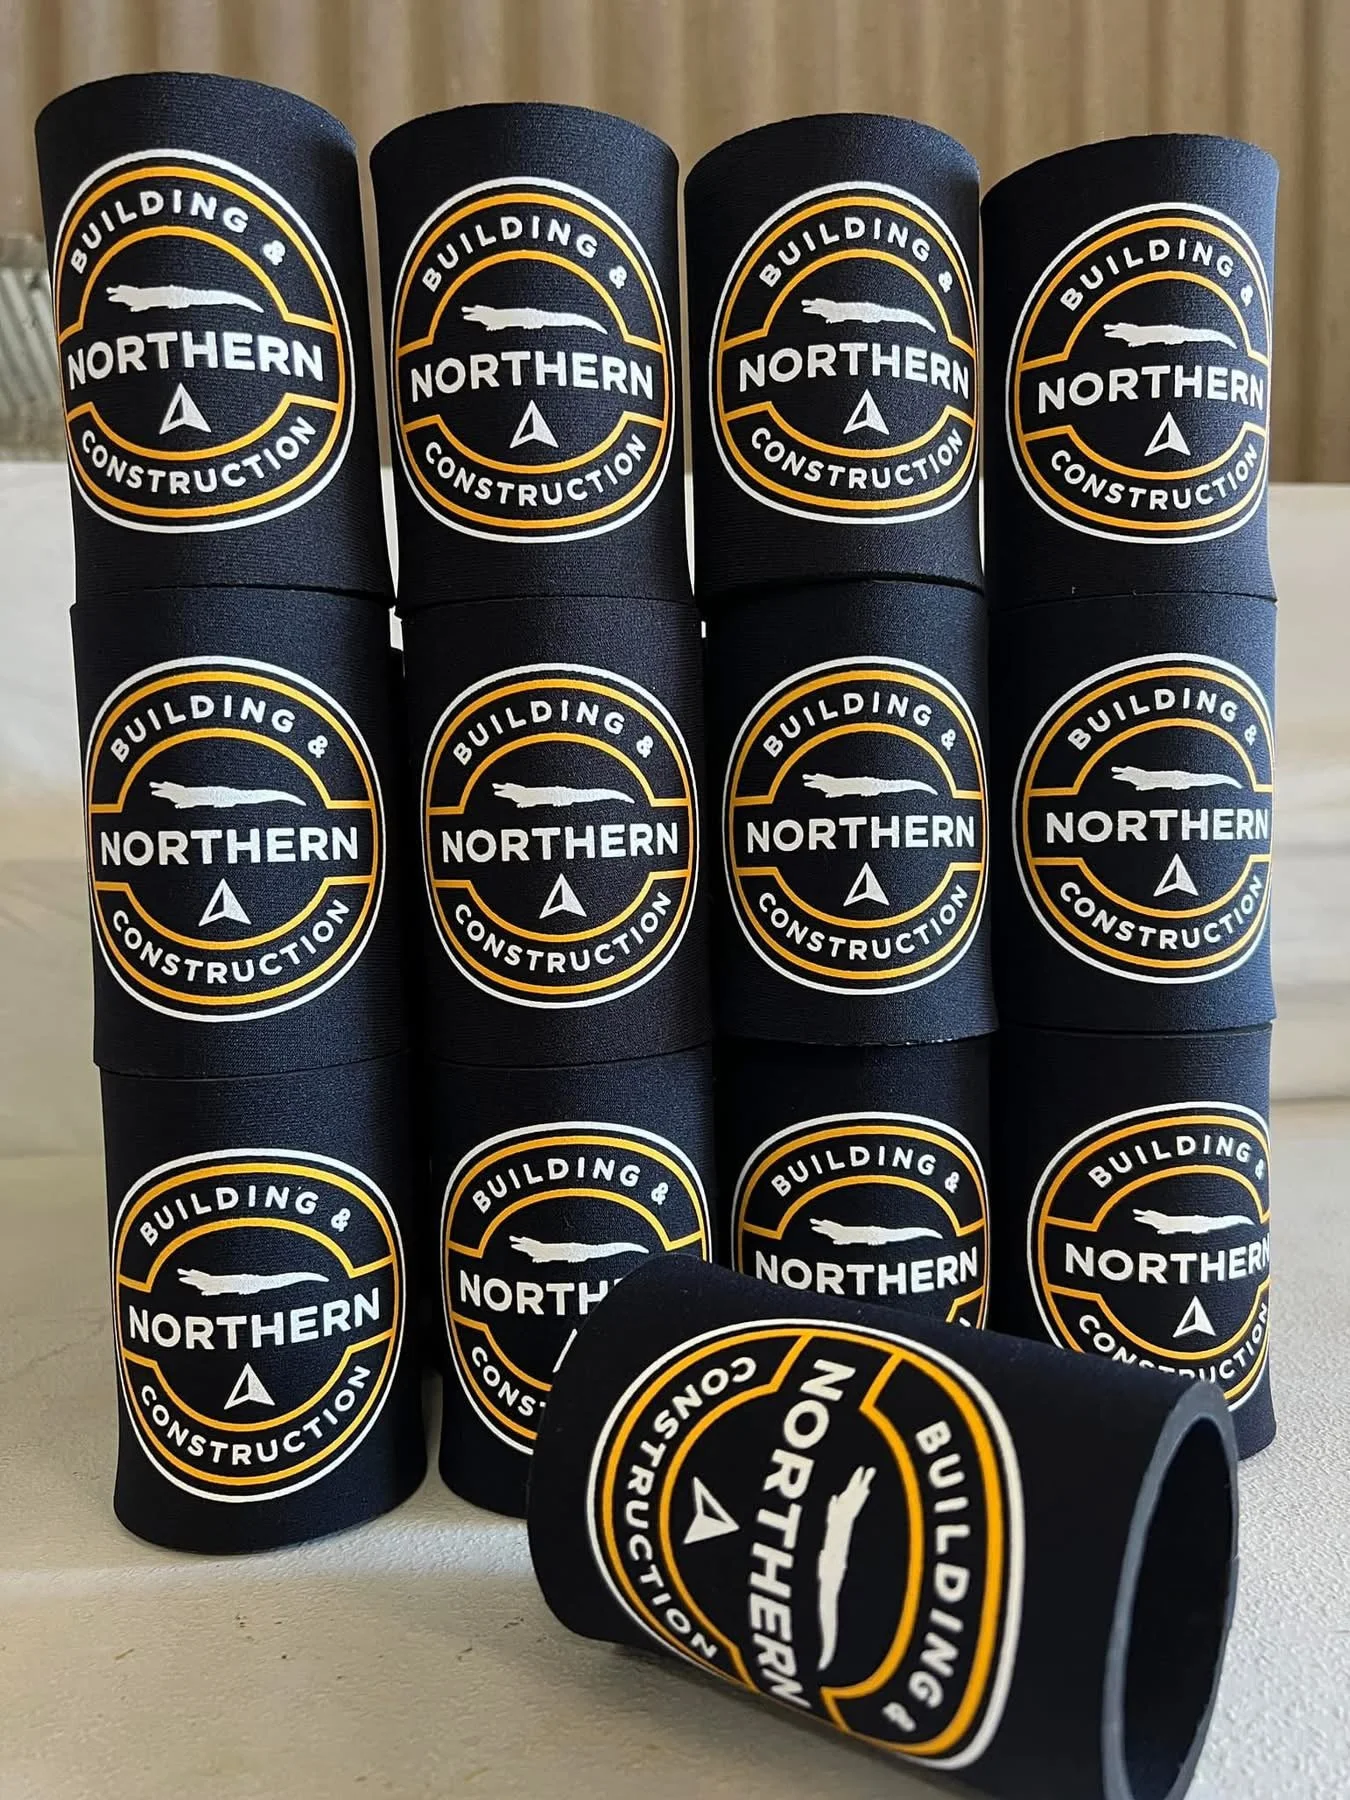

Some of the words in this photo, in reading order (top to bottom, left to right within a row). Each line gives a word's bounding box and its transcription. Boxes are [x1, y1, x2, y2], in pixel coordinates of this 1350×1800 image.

[71, 188, 248, 274] BUILDING
[260, 240, 286, 265] &
[422, 215, 597, 292] BUILDING
[608, 265, 627, 289] &
[759, 216, 930, 287] BUILDING
[938, 271, 953, 294] &
[1060, 238, 1232, 311] BUILDING
[68, 331, 323, 390] NORTHERN
[411, 351, 654, 402] NORTHERN
[739, 342, 968, 399] NORTHERN
[1038, 365, 1263, 414] NORTHERN
[81, 416, 317, 495] CONSTRUCTION
[424, 434, 646, 506] CONSTRUCTION
[751, 429, 963, 488] CONSTRUCTION
[1051, 443, 1257, 510] CONSTRUCTION
[111, 695, 296, 763] BUILDING
[308, 735, 328, 758] &
[453, 700, 625, 765] BUILDING
[636, 735, 654, 758] &
[763, 692, 932, 758] BUILDING
[941, 729, 956, 751] &
[1068, 688, 1239, 750] BUILDING
[101, 827, 358, 866] NORTHERN
[442, 823, 678, 862] NORTHERN
[747, 815, 974, 853] NORTHERN
[1046, 808, 1268, 843] NORTHERN
[113, 900, 350, 984] CONSTRUCTION
[455, 892, 672, 974] CONSTRUCTION
[759, 885, 967, 960] CONSTRUCTION
[1060, 874, 1262, 949] CONSTRUCTION
[473, 1157, 640, 1213] BUILDING
[651, 1182, 669, 1205] &
[771, 1145, 936, 1197] BUILDING
[944, 1171, 960, 1193] &
[1088, 1134, 1252, 1188] BUILDING
[140, 1185, 319, 1246] BUILDING
[331, 1208, 350, 1232] &
[756, 1246, 977, 1295] NORTHERN
[1065, 1233, 1270, 1284] NORTHERN
[129, 1288, 380, 1350] NORTHERN
[460, 1270, 623, 1315] NORTH
[142, 1363, 371, 1466] CONSTRUCTION
[626, 1356, 756, 1660] CONSTRUCTION
[748, 1358, 855, 1709] NORTHERN
[909, 1421, 971, 1708] BUILDING
